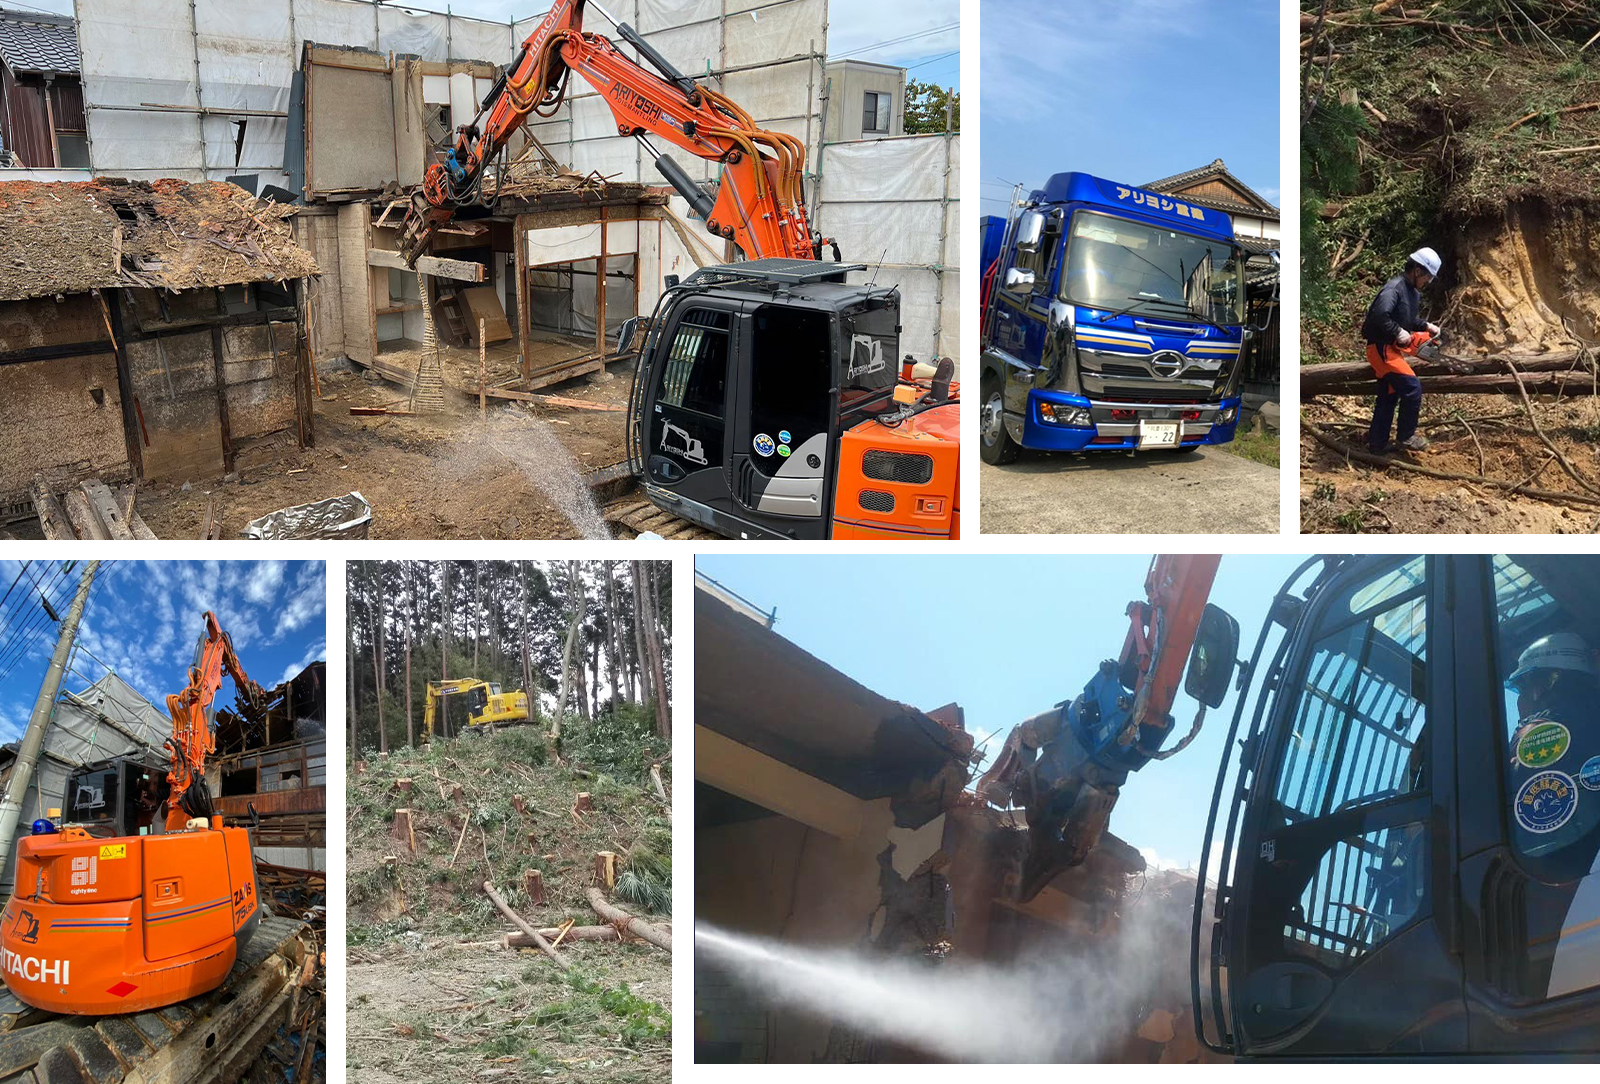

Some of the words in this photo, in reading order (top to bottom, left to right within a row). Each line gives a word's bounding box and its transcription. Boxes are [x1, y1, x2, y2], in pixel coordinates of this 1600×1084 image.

[528, 3, 561, 57] HITACHI
[609, 80, 664, 120] ARIYOSHI
[617, 98, 658, 127] DISMANTLING
[1162, 432, 1174, 442] 22
